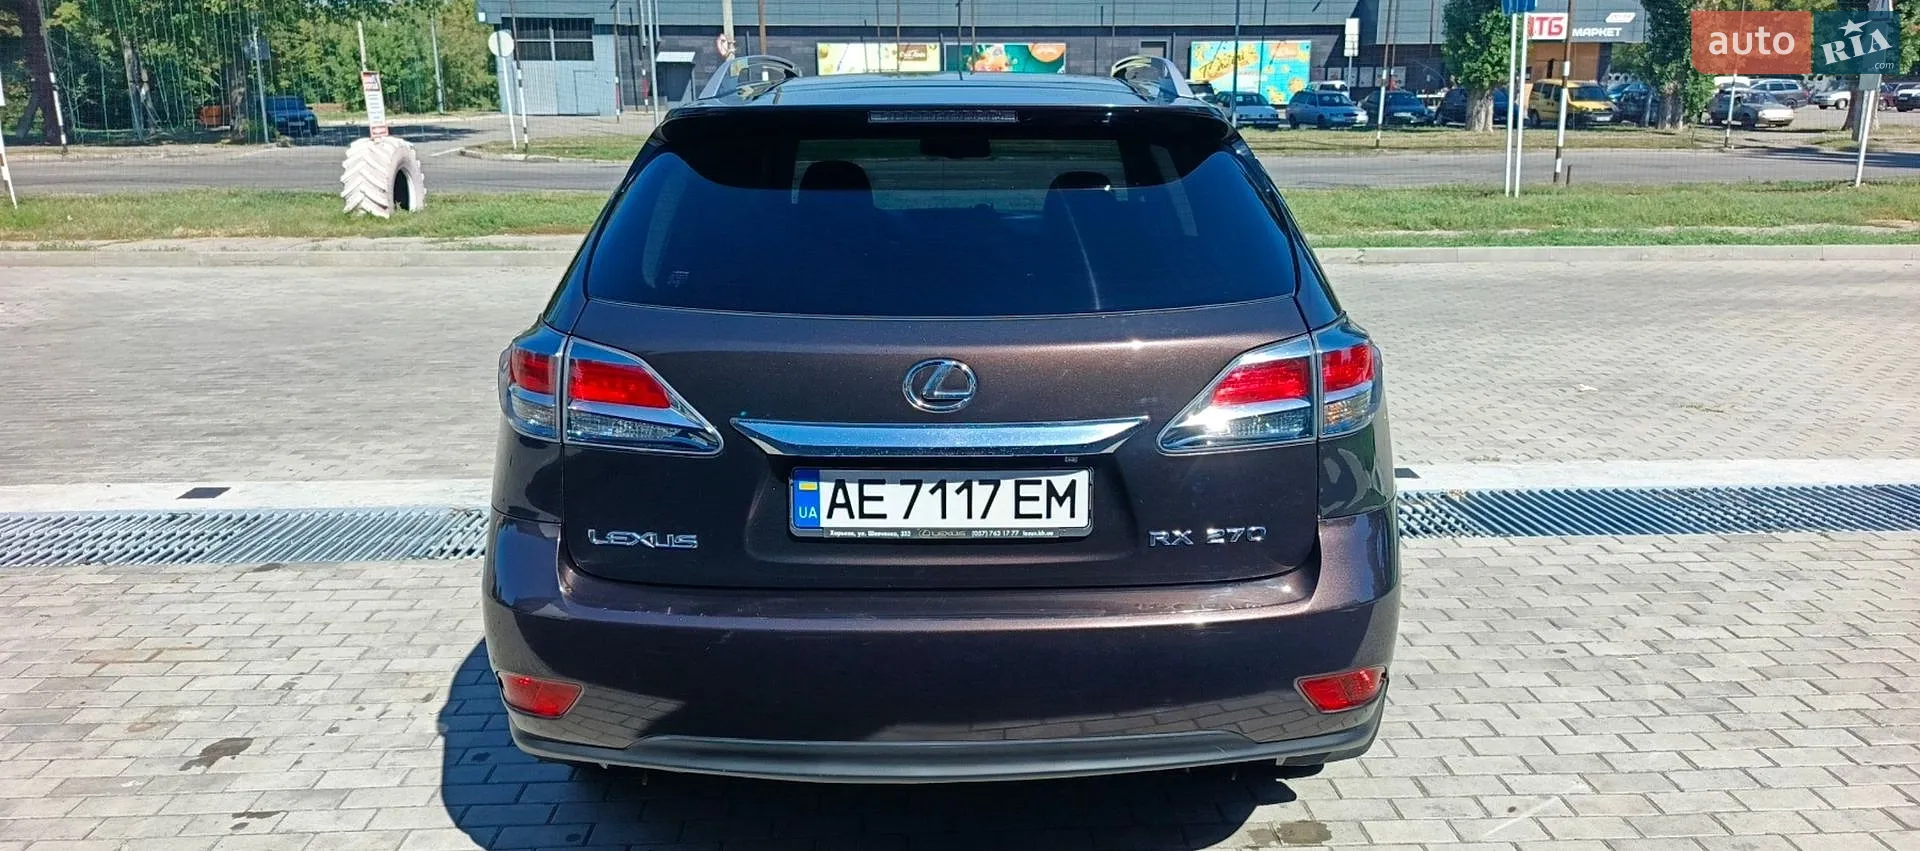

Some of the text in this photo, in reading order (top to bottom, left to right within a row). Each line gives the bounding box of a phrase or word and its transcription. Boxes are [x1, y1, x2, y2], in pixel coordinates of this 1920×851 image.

[1572, 27, 1622, 37] МАРКЕТ
[826, 478, 1076, 519] AE 7117 EM
[799, 506, 818, 519] UA
[587, 528, 699, 548] LEXUS
[1149, 526, 1267, 546] RX 270
